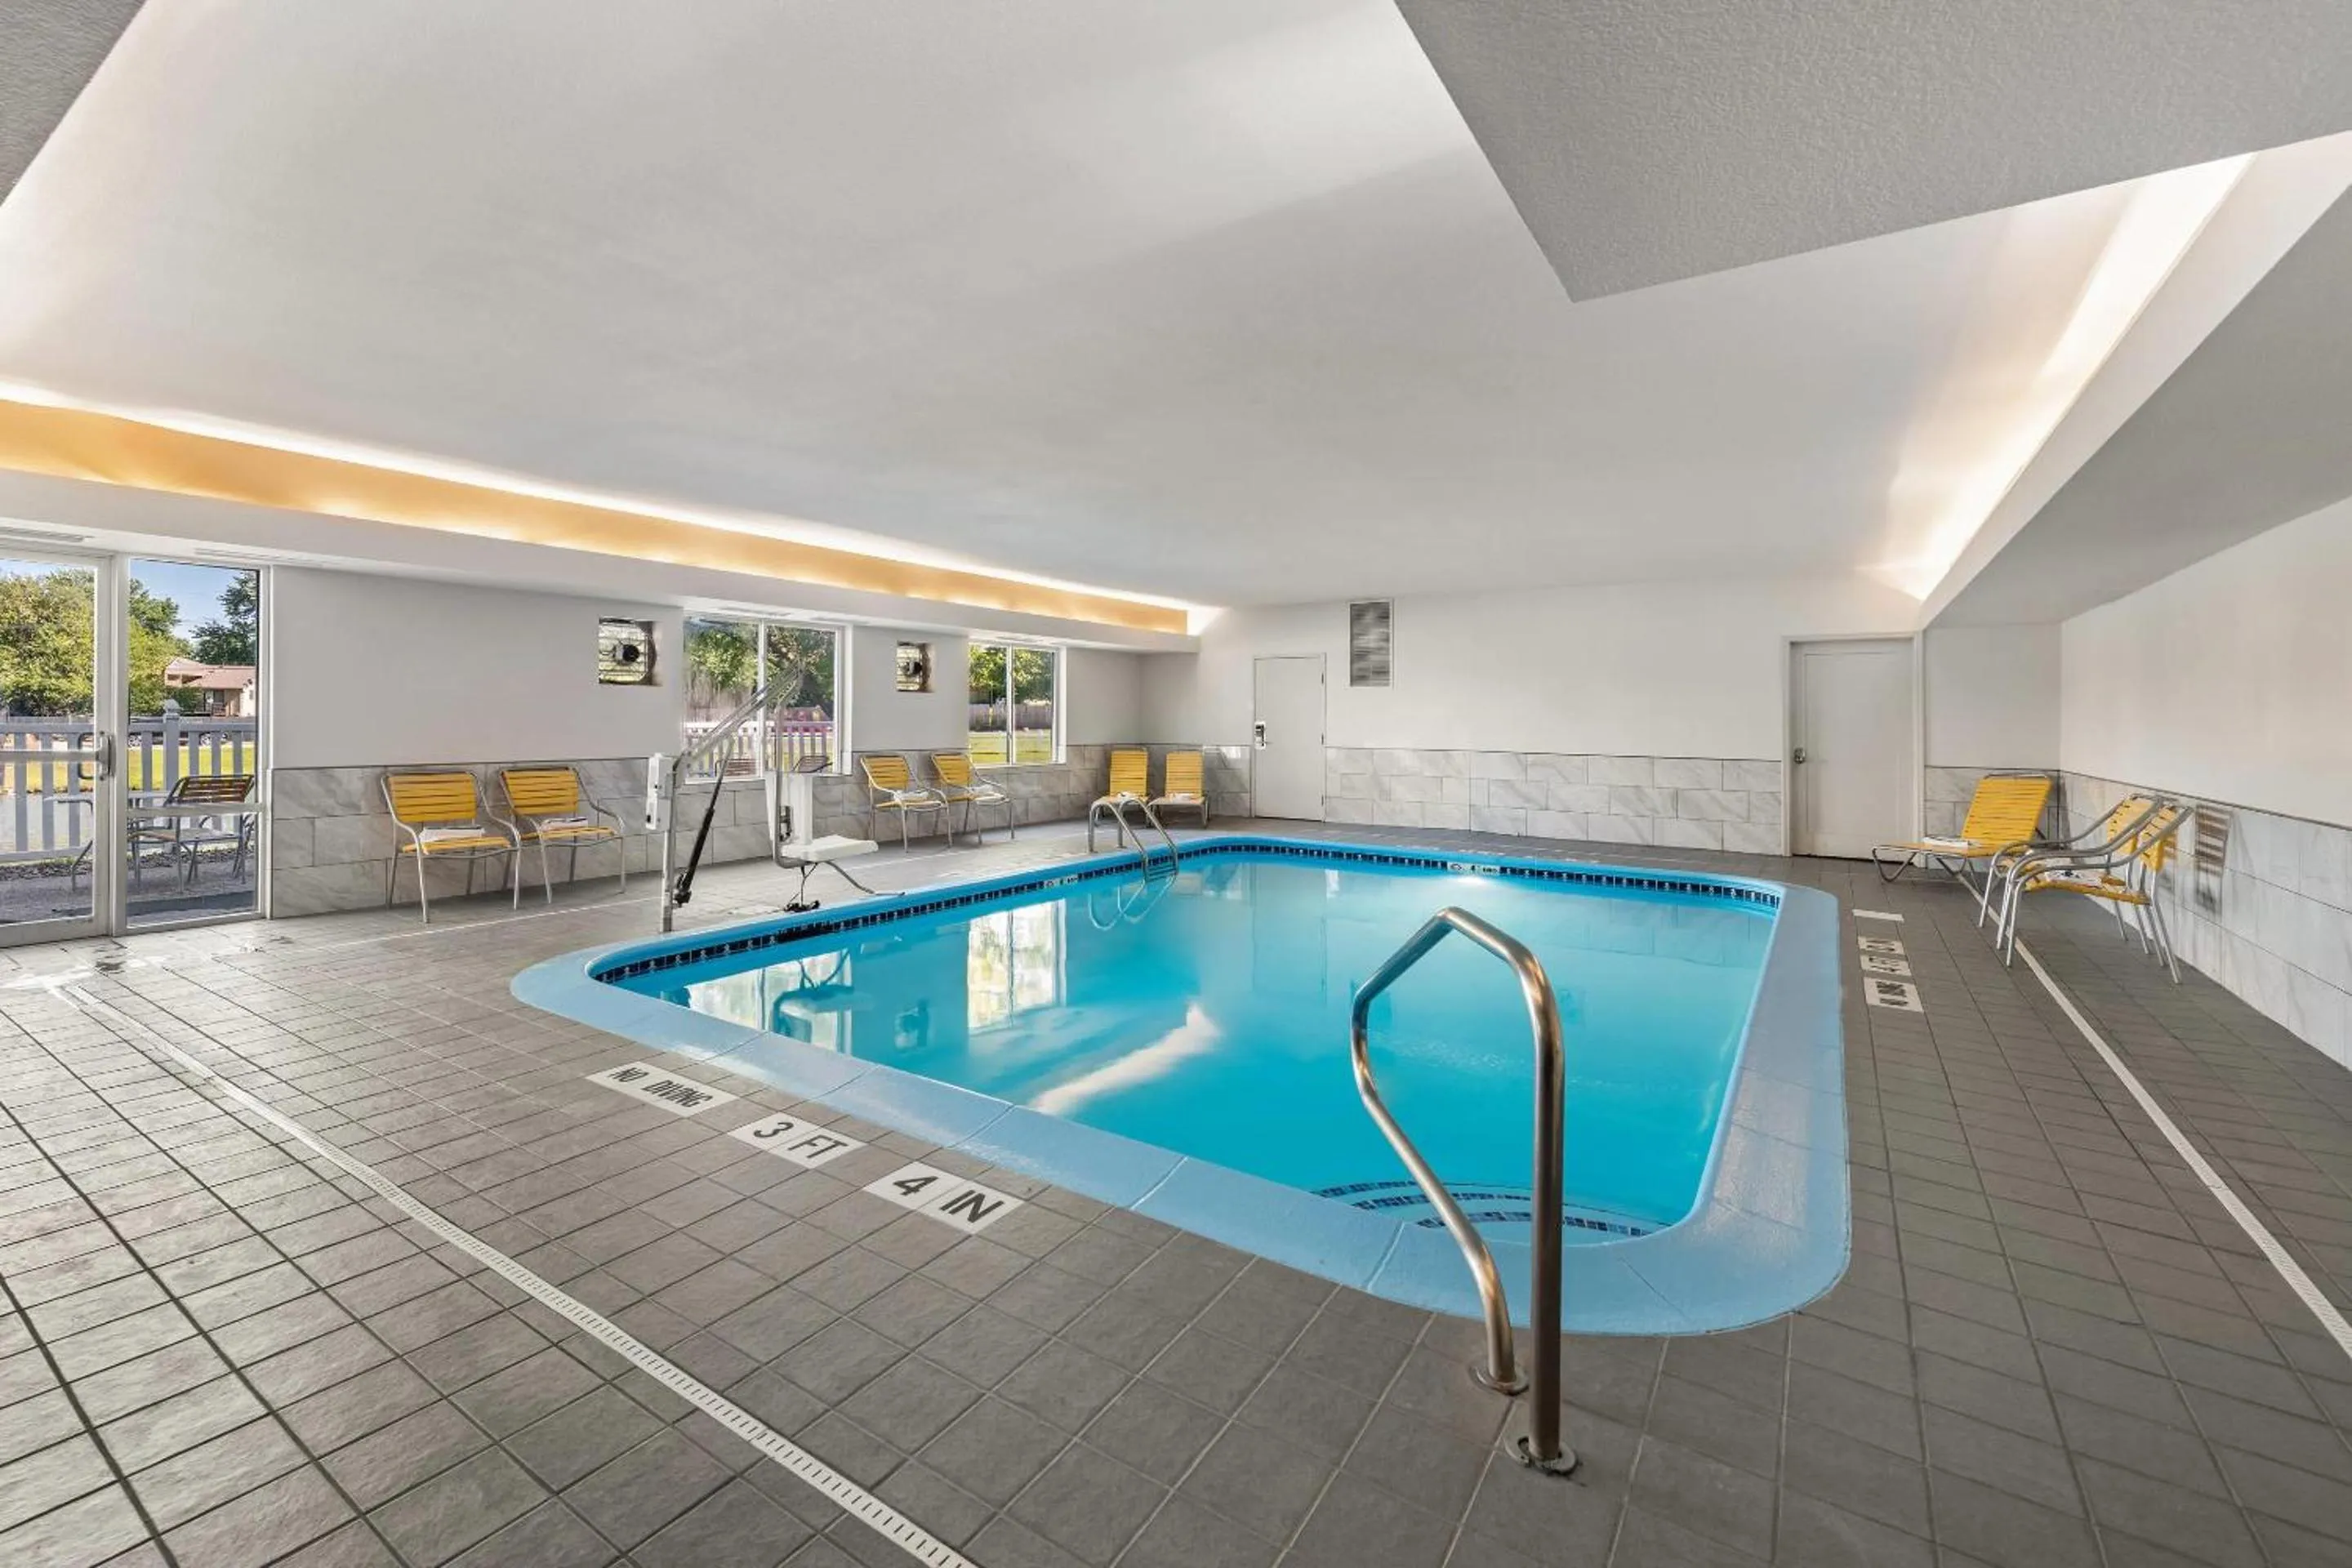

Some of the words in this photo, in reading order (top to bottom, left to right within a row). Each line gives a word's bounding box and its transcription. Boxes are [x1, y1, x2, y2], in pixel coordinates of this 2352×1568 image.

[607, 1067, 649, 1082] NO
[641, 1080, 713, 1107] DIVING
[753, 1121, 794, 1138] 3
[787, 1134, 849, 1159] FT
[893, 1175, 939, 1196] 4
[939, 1189, 1004, 1223] IN
